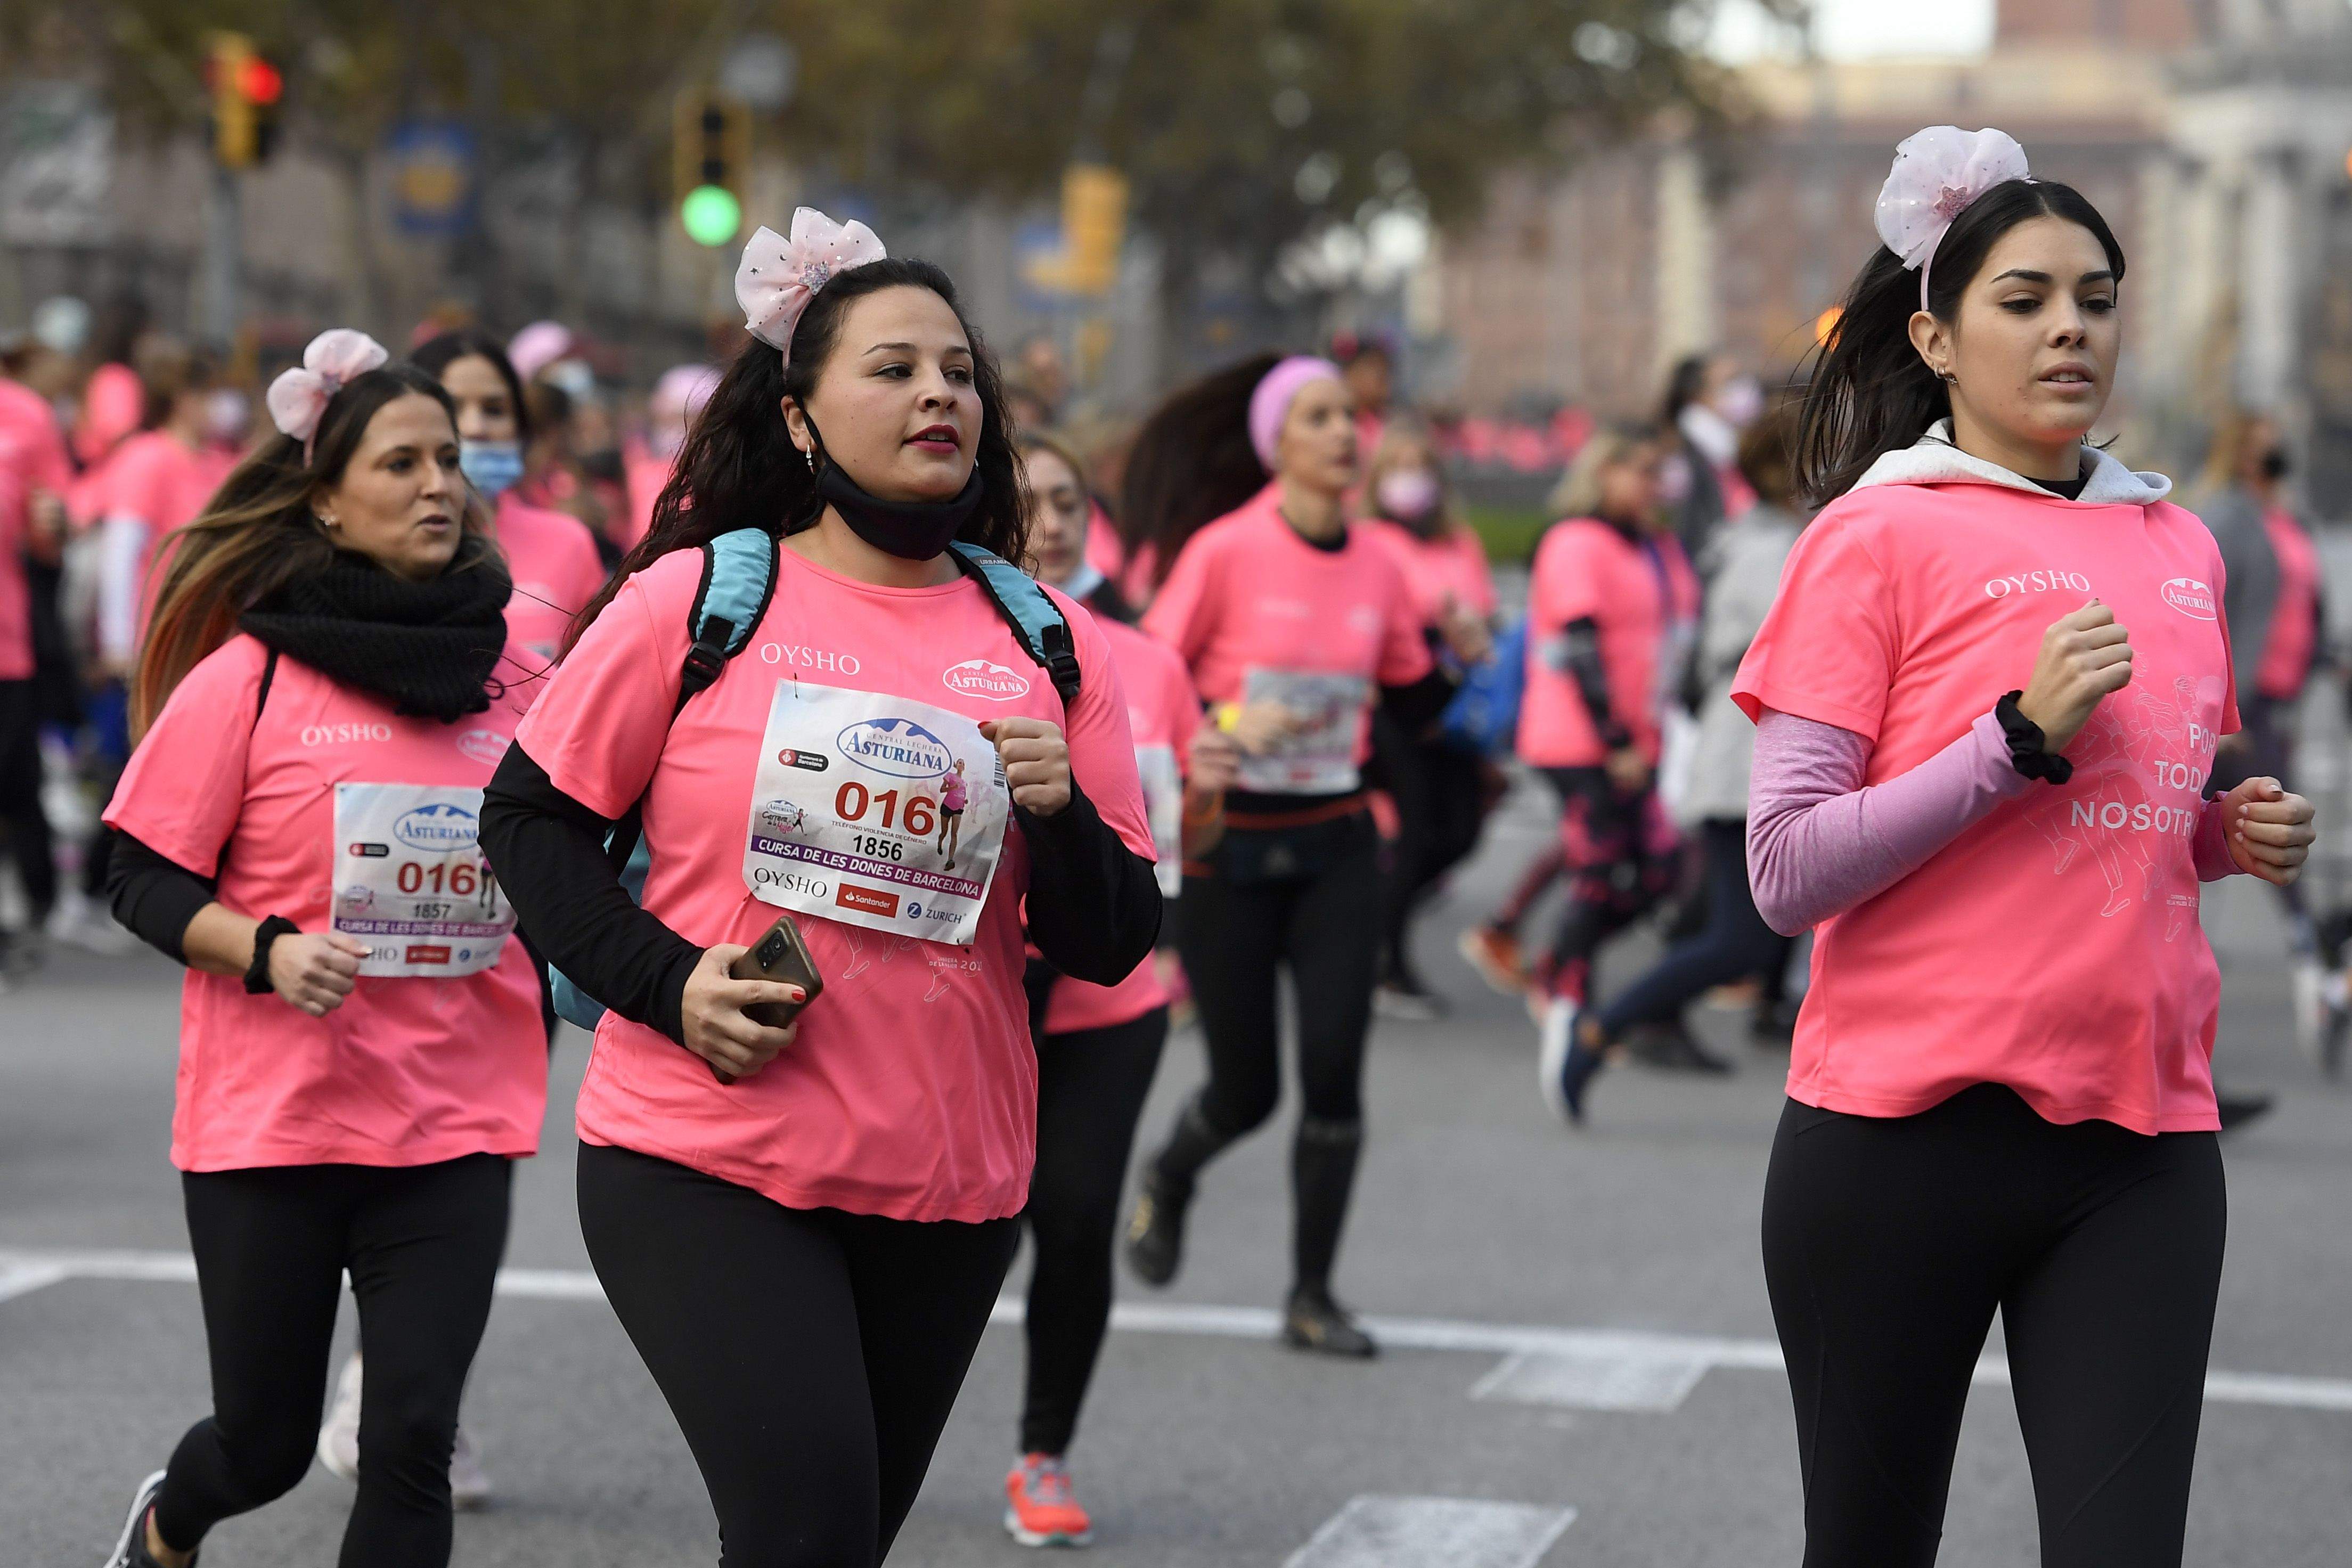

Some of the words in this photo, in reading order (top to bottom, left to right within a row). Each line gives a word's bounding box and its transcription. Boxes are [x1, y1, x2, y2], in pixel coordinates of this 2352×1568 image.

[1985, 570, 2090, 599] OYSHO
[2169, 587, 2216, 614] ASTURIAN
[760, 642, 860, 675] OYSHO
[951, 672, 1024, 692] ASTURIANA
[301, 723, 392, 747] OYSHO
[866, 732, 902, 745] CENTRAL
[907, 741, 942, 754] LECHERA
[2188, 723, 2216, 757] POR
[844, 731, 943, 771] ASTURIANA
[835, 781, 936, 836] 016
[2071, 801, 2196, 837] NOSOTR
[831, 820, 862, 831] TELÉFONO
[863, 828, 894, 838] VIOLENCIA
[903, 835, 927, 845] GÉNERO
[853, 835, 903, 861] 1856
[397, 862, 476, 895] 016
[758, 839, 799, 858] CURSA
[803, 848, 822, 862] DE
[823, 853, 848, 868] LES
[849, 859, 893, 878] DONES
[894, 868, 910, 882] DE
[912, 872, 980, 897] BARCELONA
[754, 867, 827, 898] OYSHO
[854, 894, 891, 909] Santander
[414, 903, 451, 918] 1857
[926, 909, 962, 924] ZURICH
